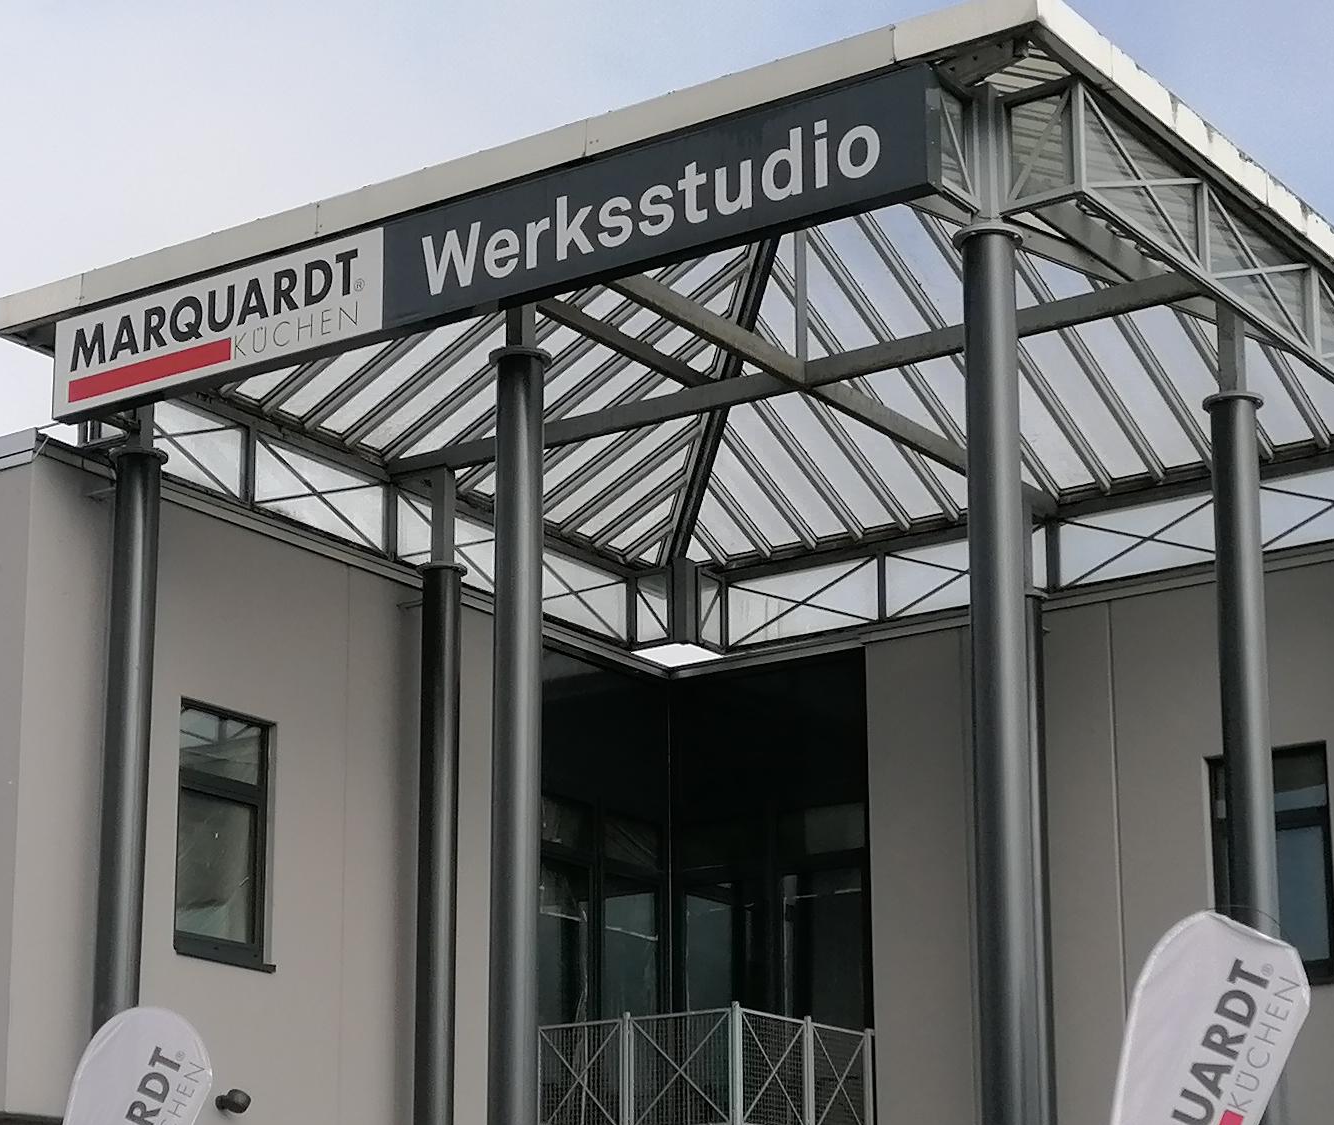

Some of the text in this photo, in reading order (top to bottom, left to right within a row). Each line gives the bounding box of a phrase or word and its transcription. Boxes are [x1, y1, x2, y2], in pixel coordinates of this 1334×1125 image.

[421, 119, 881, 296] Werksstudio
[69, 248, 359, 373] MARQUARDT
[234, 301, 359, 360] KÜCHEN
[1227, 975, 1301, 1113] KÜCHEN
